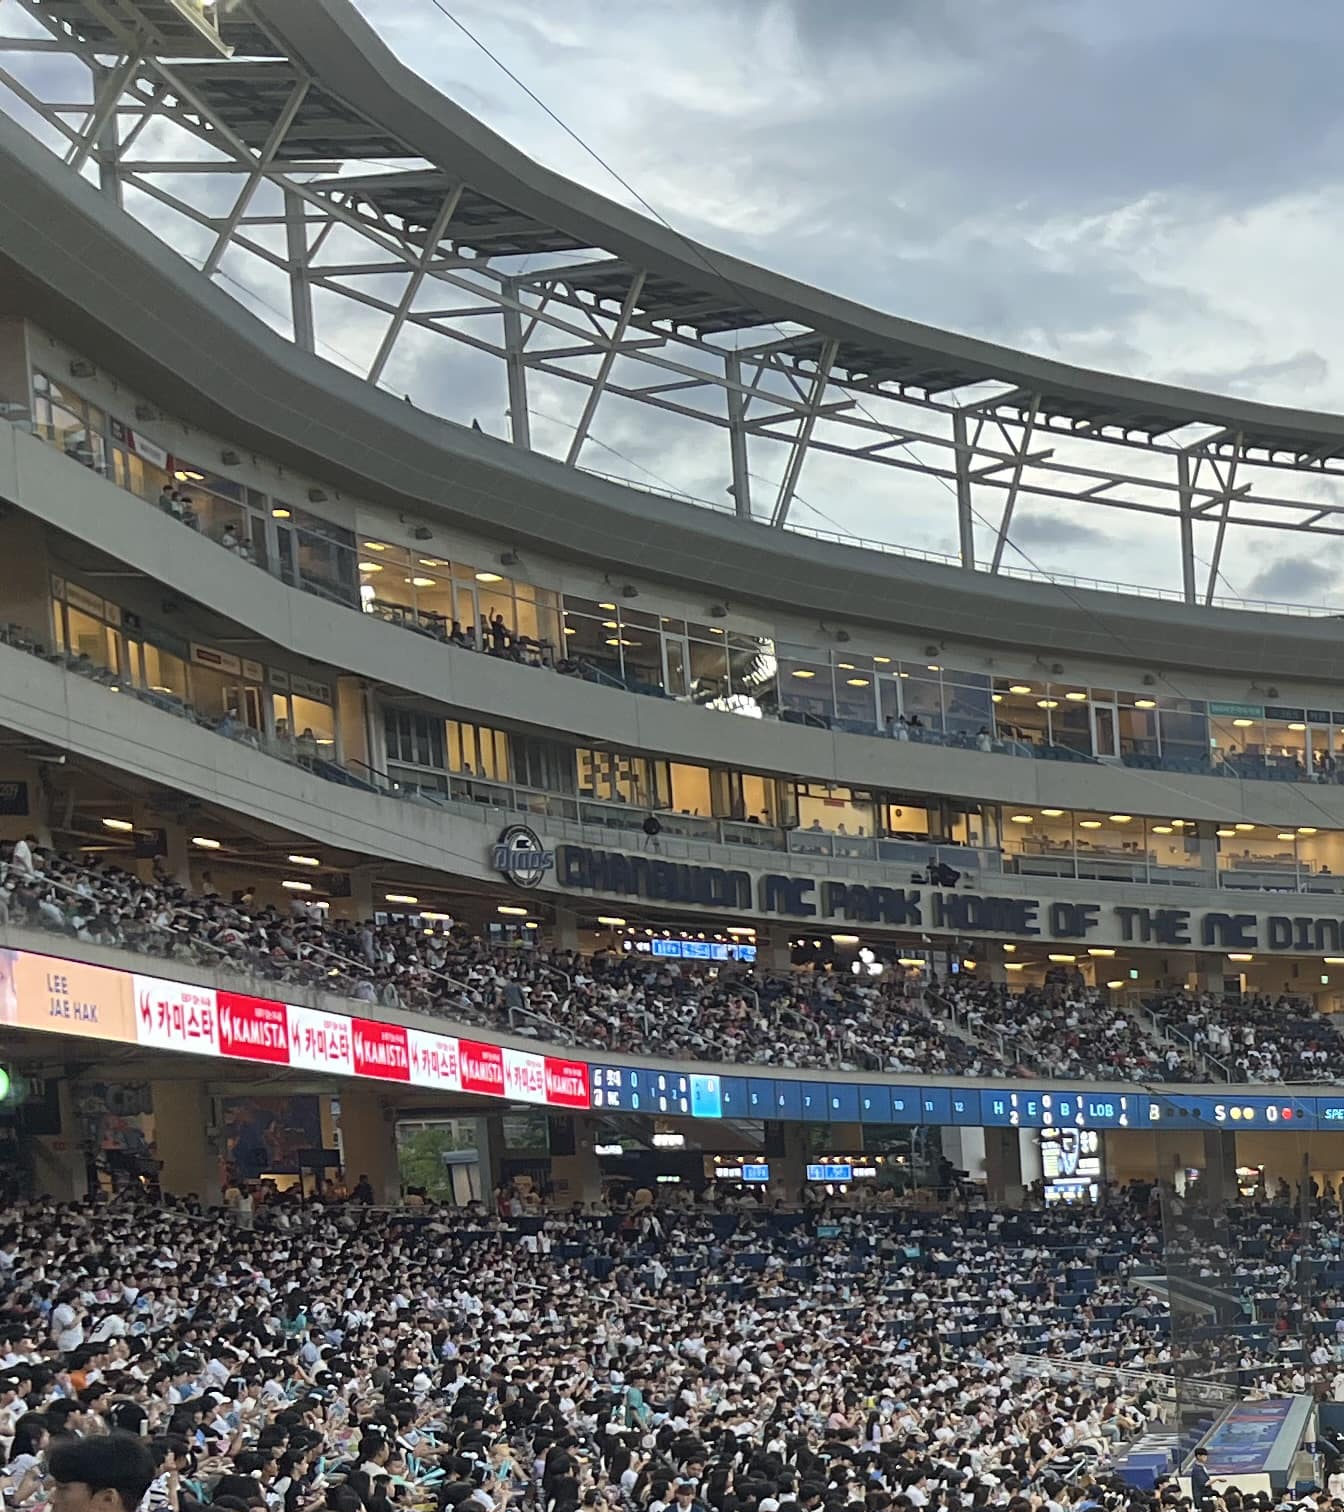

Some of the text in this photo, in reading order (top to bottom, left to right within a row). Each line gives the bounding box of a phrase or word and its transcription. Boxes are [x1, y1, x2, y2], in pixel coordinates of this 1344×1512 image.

[821, 881, 922, 926] PARK
[933, 890, 1041, 936] HOME
[1048, 902, 1101, 938] OF
[1114, 905, 1192, 946] THE
[1200, 912, 1259, 949] NC
[46, 972, 69, 995] LEE
[49, 997, 98, 1023] JAE HAK
[157, 1000, 215, 1044] 카미스타
[233, 1015, 288, 1049] KAMISTA
[305, 1027, 350, 1064] 카미스타
[364, 1039, 408, 1067] KAMISTA
[422, 1049, 458, 1082] 카미스타
[468, 1059, 503, 1083] KAMISTA
[551, 1074, 586, 1097] KAMISTA
[631, 1071, 638, 1088] 0
[632, 1093, 639, 1110] 0
[751, 1093, 758, 1105] 5
[805, 1096, 811, 1107] 7
[864, 1099, 871, 1109] 9
[894, 1099, 904, 1111] 10
[925, 1101, 934, 1111] 11
[954, 1101, 964, 1112] 12
[993, 1101, 1004, 1115] H
[1028, 1102, 1036, 1116] E
[1041, 1094, 1051, 1109] 0
[1060, 1103, 1069, 1116] B
[1076, 1095, 1083, 1109] 1
[1089, 1103, 1114, 1117] LOB
[1120, 1096, 1127, 1110] 1
[1149, 1104, 1160, 1121] B
[1214, 1105, 1225, 1121] S
[1010, 1111, 1019, 1125] 2
[1042, 1111, 1052, 1125] 0
